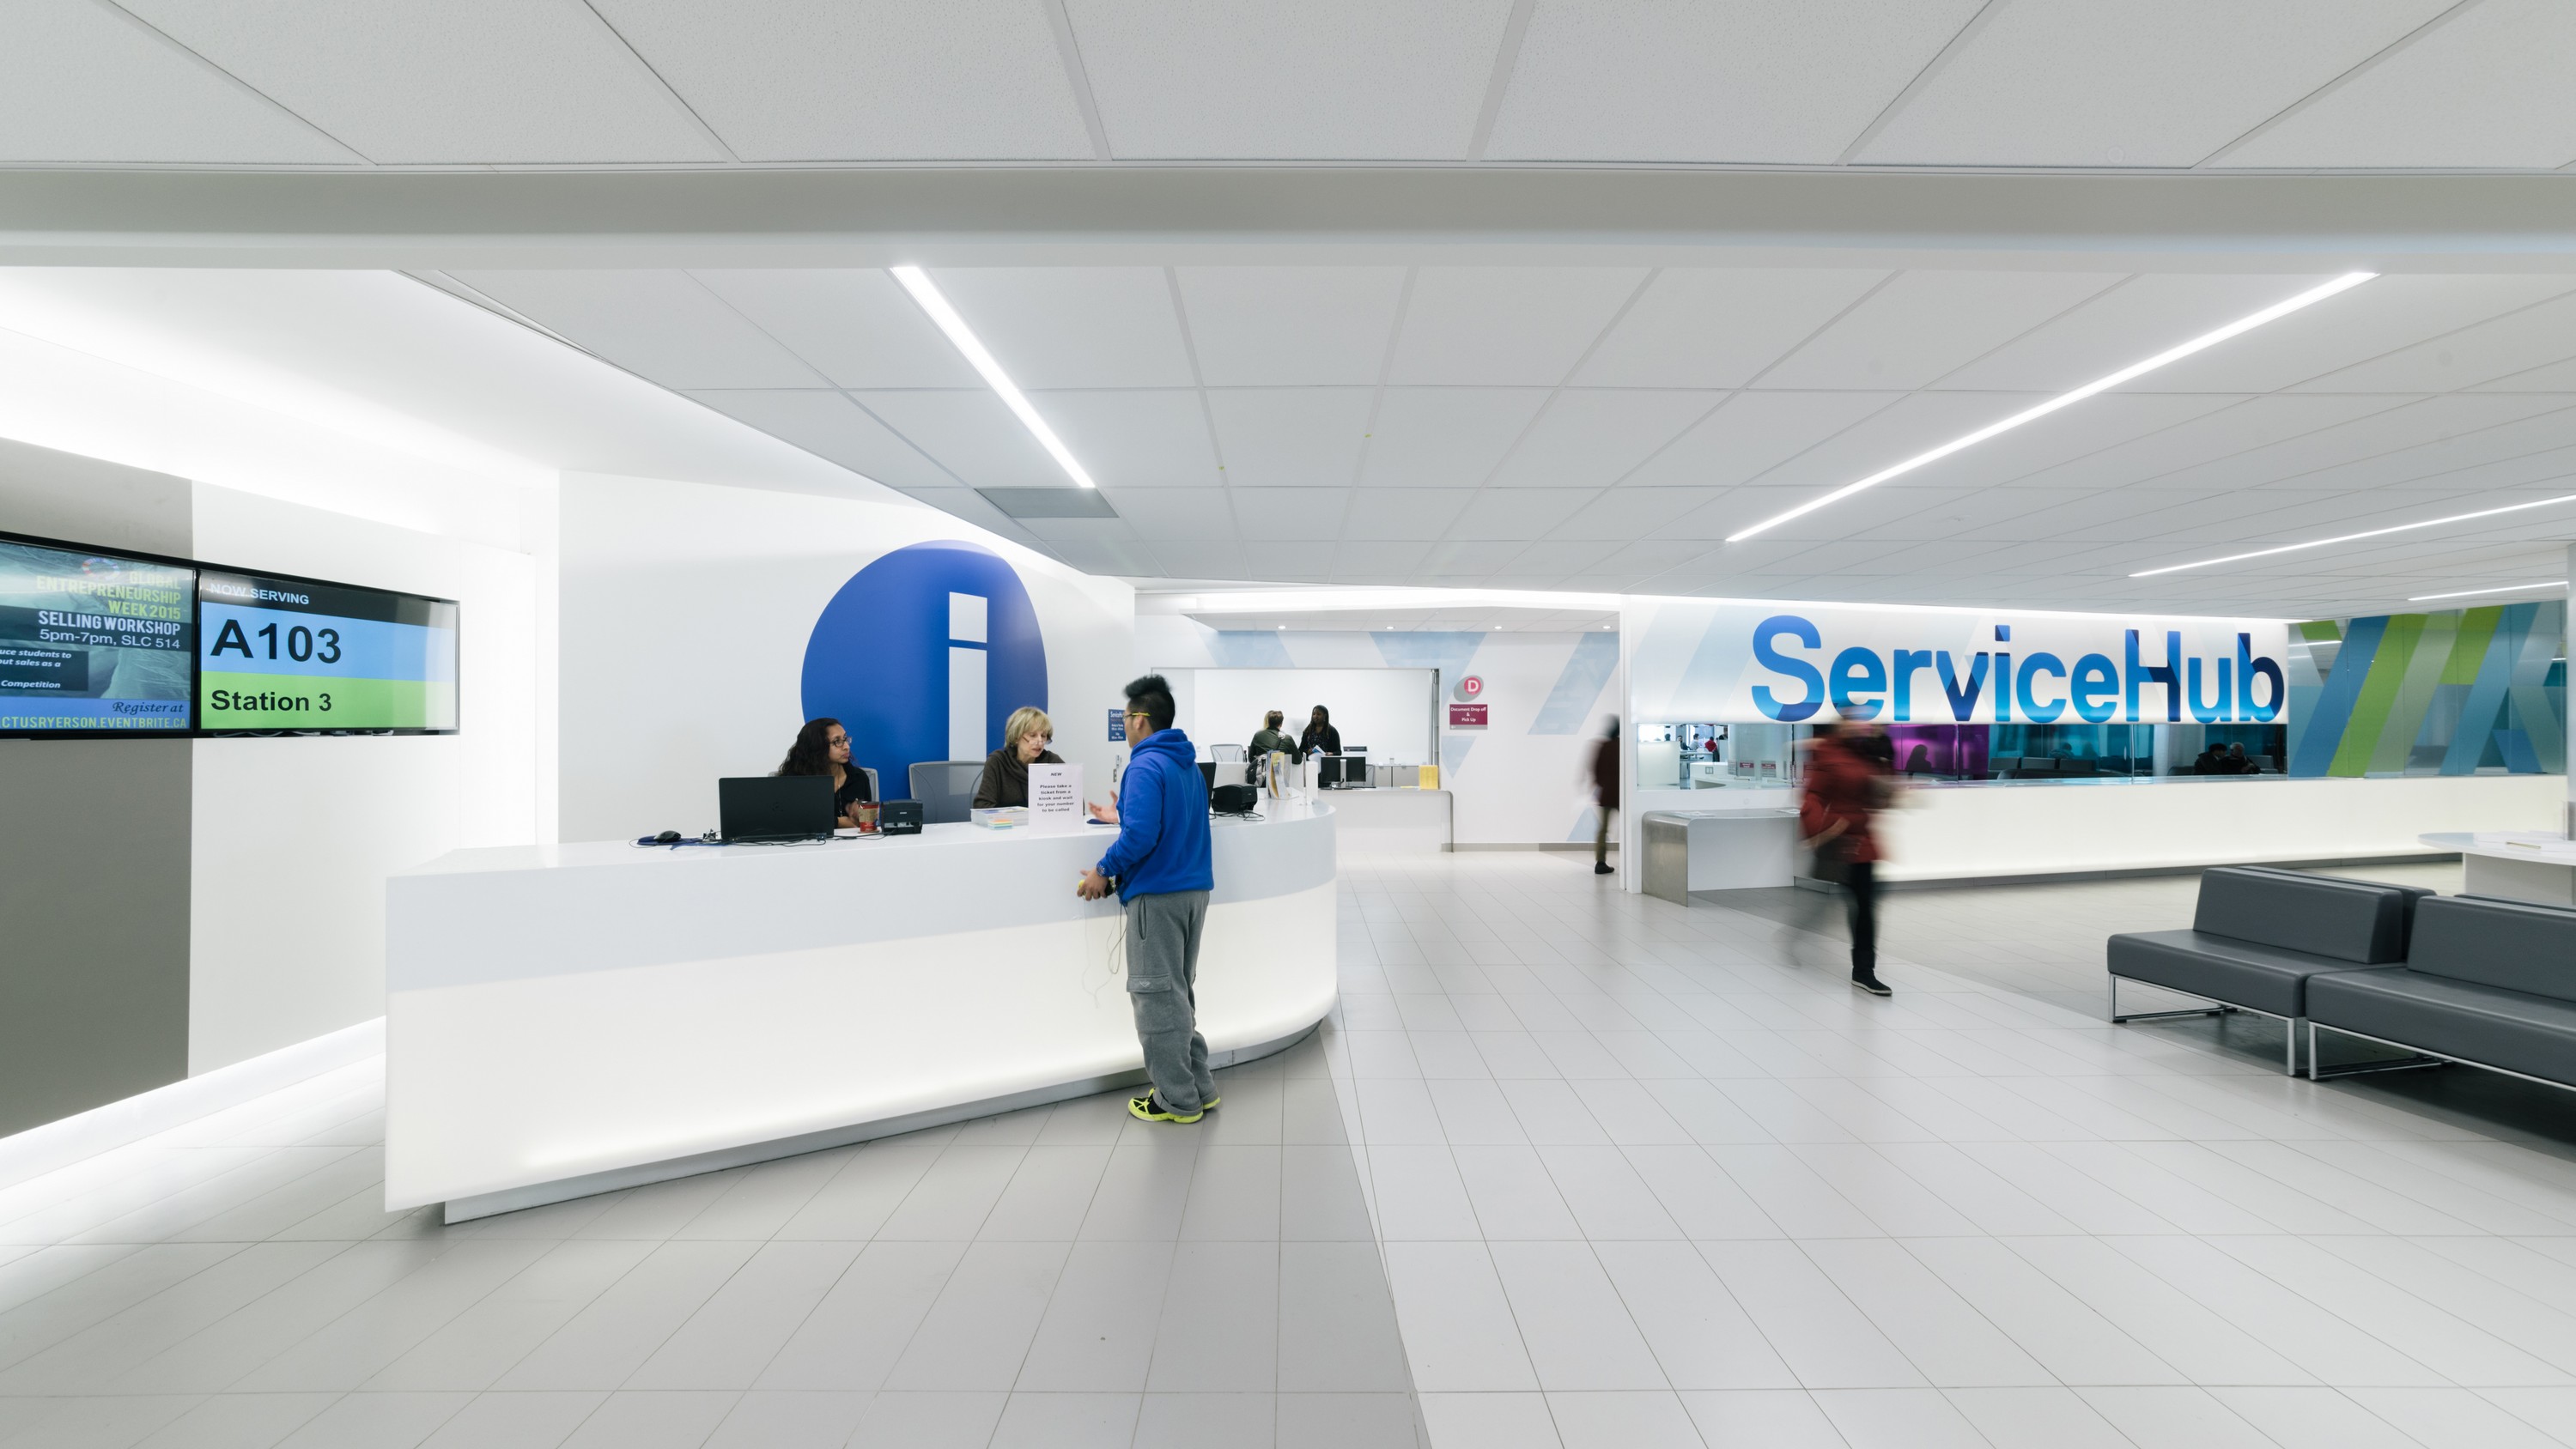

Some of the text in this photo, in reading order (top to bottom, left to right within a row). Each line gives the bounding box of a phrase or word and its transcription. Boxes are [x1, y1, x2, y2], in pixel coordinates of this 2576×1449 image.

[36, 576, 181, 604] ENTREPRENEURSHIP
[129, 571, 181, 590] GLOBAL
[210, 583, 310, 605] NOW SERVING
[108, 600, 181, 620] WEEK 2015
[38, 610, 181, 636] SELLING WORKSHOP
[39, 629, 181, 649] 5pm-7pm, SLC 514
[210, 619, 342, 664] A103
[18, 650, 60, 658] students
[1751, 615, 2285, 724] ServiceHub
[1, 680, 61, 688] Competition
[1467, 680, 1479, 692] D
[112, 701, 168, 715] Register
[211, 690, 331, 712] Station 3
[2, 716, 186, 729] CTUSRYERSON.EVENTBRITE.CA
